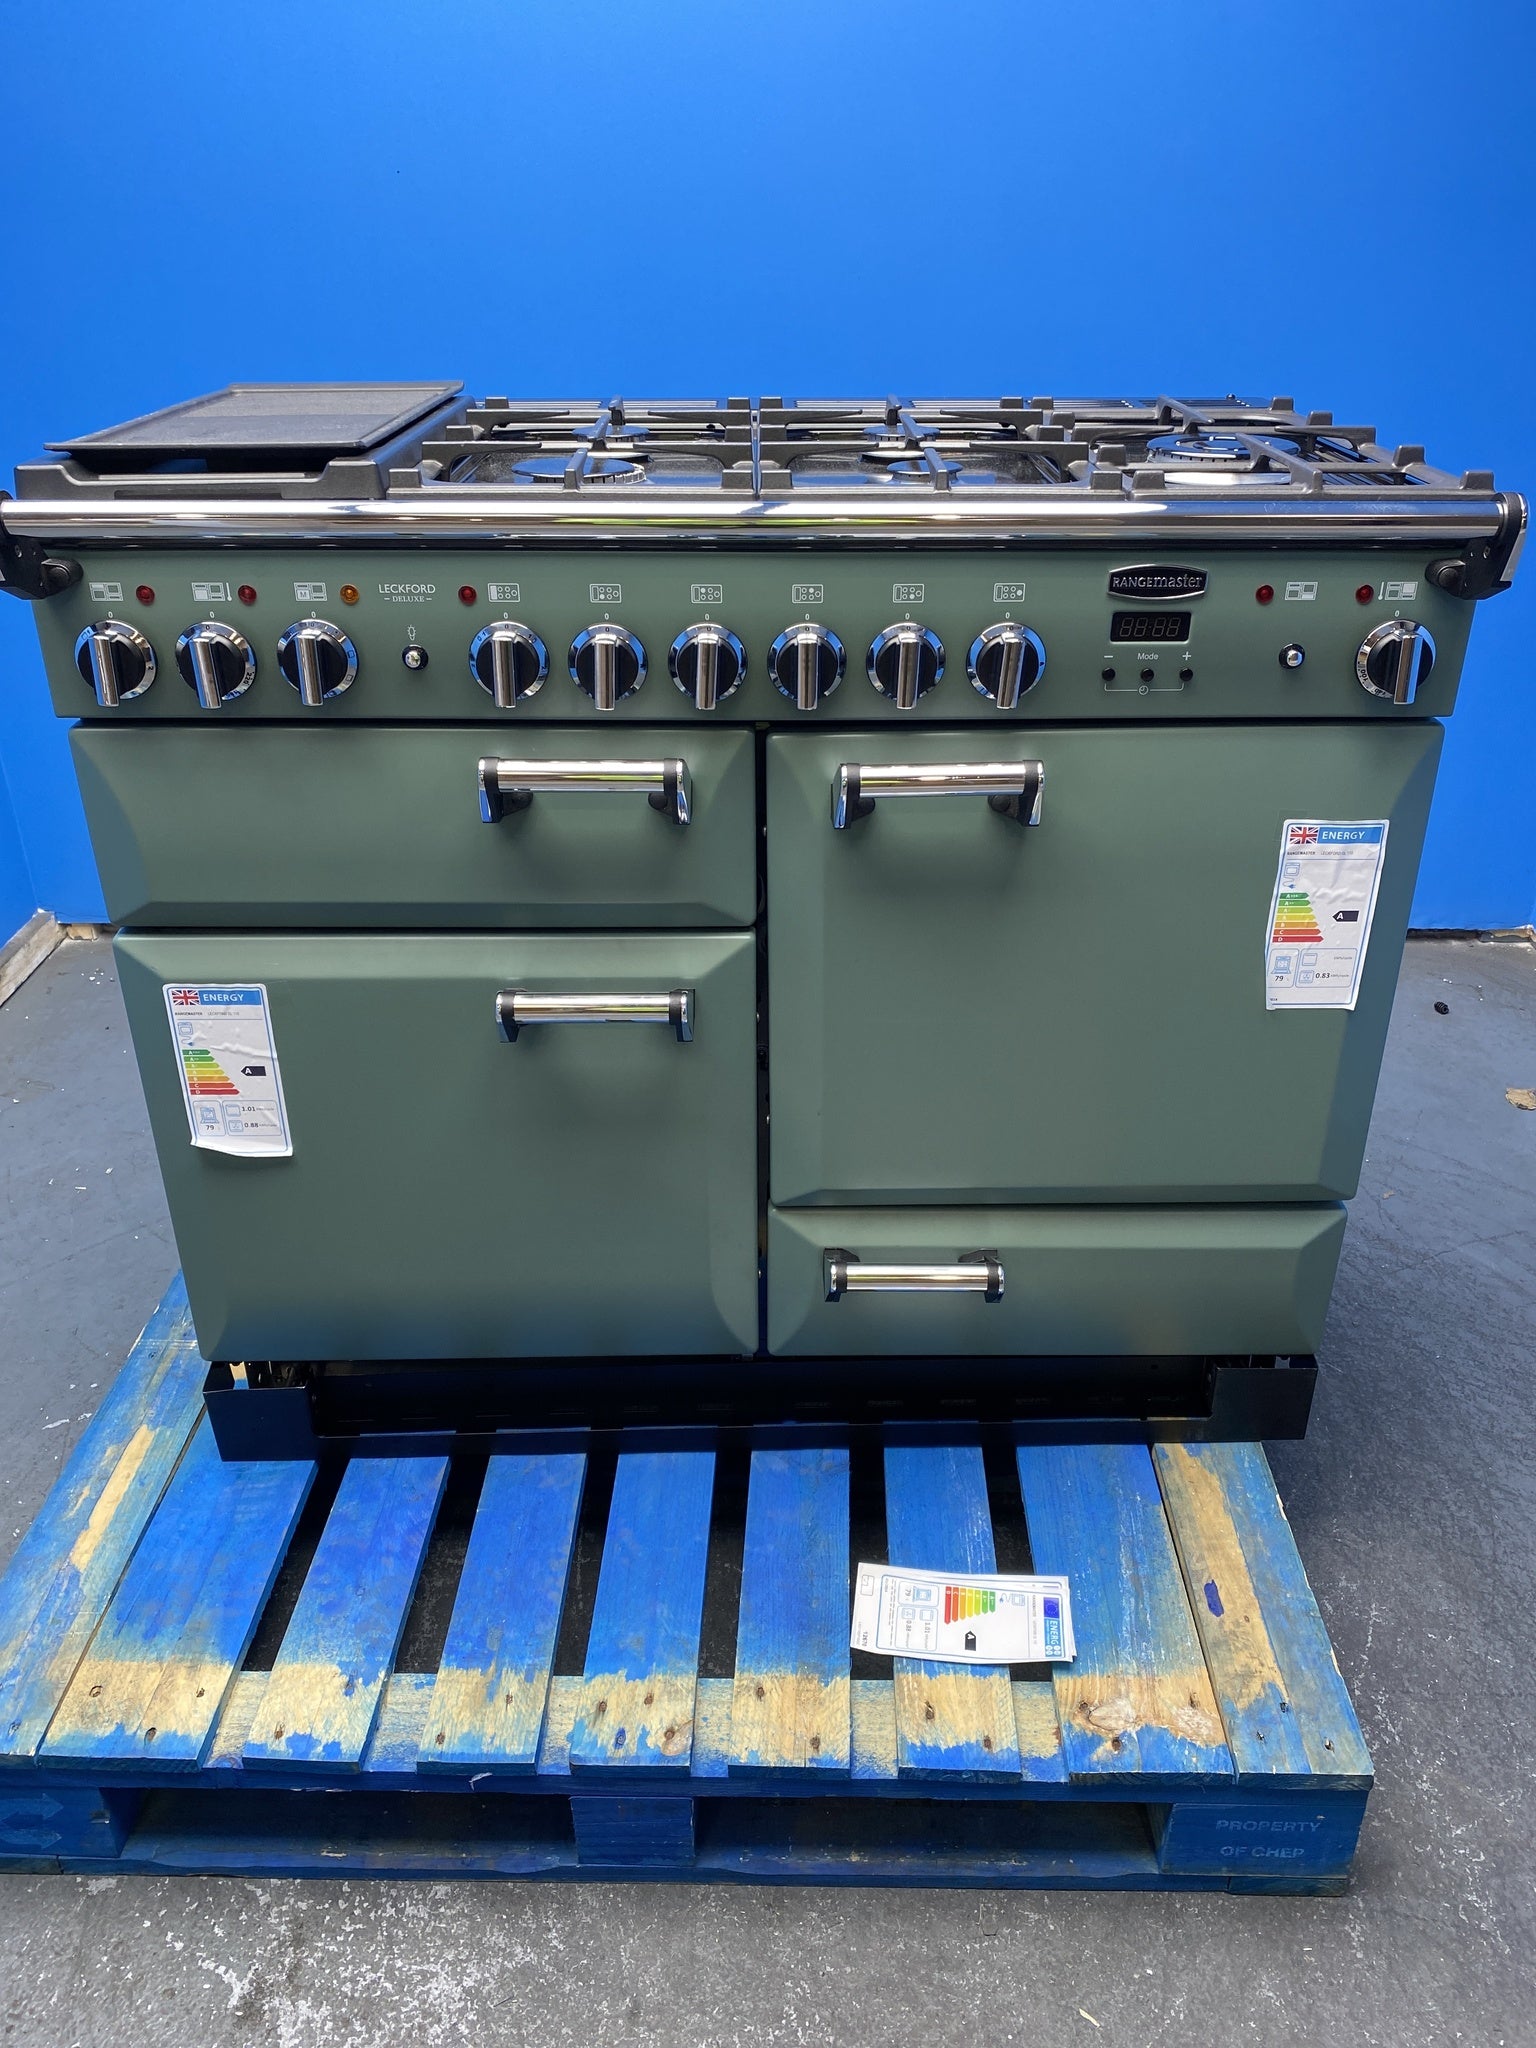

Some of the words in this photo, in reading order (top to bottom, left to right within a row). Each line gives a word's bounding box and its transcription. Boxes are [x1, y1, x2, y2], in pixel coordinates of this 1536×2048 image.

[378, 584, 436, 594] LECKFORD
[1137, 652, 1159, 660] Mode
[1322, 831, 1366, 840] ENERGY
[1336, 912, 1344, 920] A
[203, 993, 244, 1002] ENERGY
[244, 1067, 253, 1075] A
[904, 1588, 912, 1597] 79
[1216, 1819, 1321, 1832] PROPERTY
[1220, 1846, 1249, 1857] OF
[1251, 1846, 1305, 1859] CHEP
